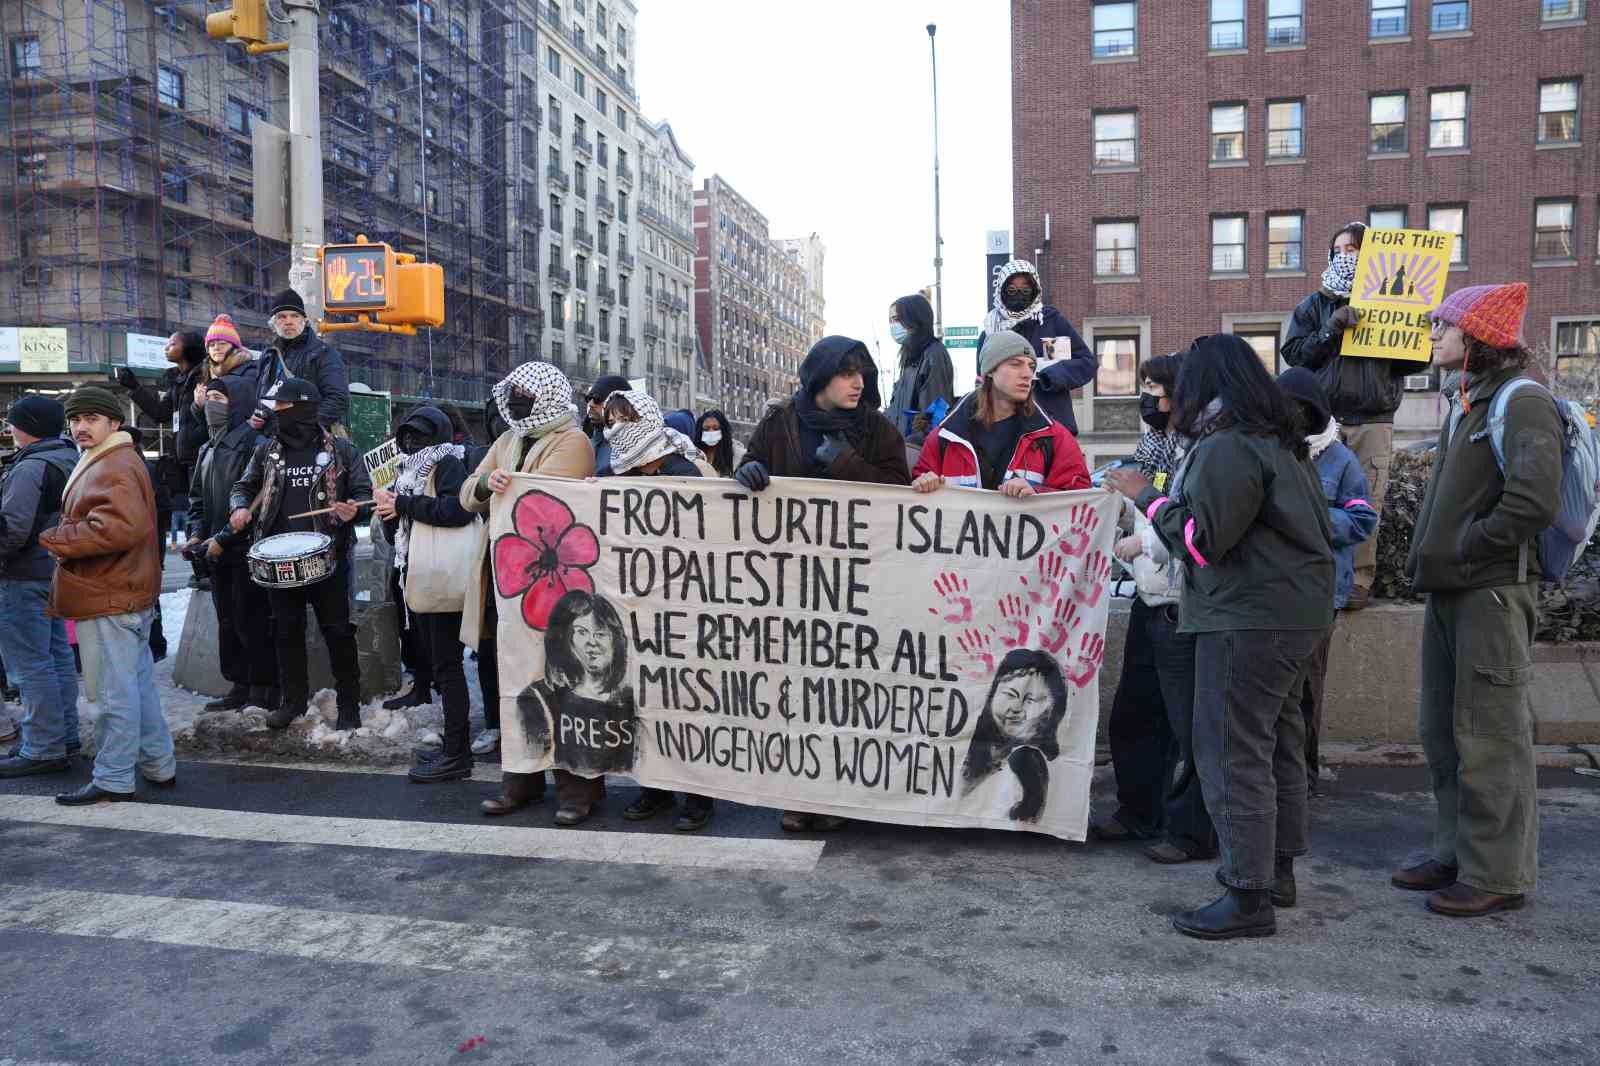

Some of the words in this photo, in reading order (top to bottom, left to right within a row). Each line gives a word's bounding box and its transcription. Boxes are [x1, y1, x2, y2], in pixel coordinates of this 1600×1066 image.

[1371, 231, 1406, 247] FOR
[1411, 233, 1447, 250] THE
[1358, 308, 1427, 329] PEOPLE
[24, 342, 65, 353] KINGS
[1351, 327, 1375, 347] WE
[1379, 329, 1424, 351] LOVE
[287, 466, 313, 477] FUCK
[365, 452, 380, 473] NO
[379, 442, 395, 464] ONE
[291, 478, 310, 488] ICE
[600, 488, 705, 540] FROM
[722, 492, 871, 551] TURTLE
[896, 503, 1046, 561] ISLAND
[611, 546, 656, 598] TO
[662, 545, 871, 617] PALESTINE
[630, 611, 688, 661] WE
[696, 613, 880, 670] REMEMBER
[891, 629, 959, 682] ALL
[638, 664, 771, 721] MISSING
[802, 676, 969, 738] MURDERED
[560, 712, 634, 749] PRESS
[656, 720, 822, 780] INDIGENOUS
[833, 735, 955, 798] WOMEN
